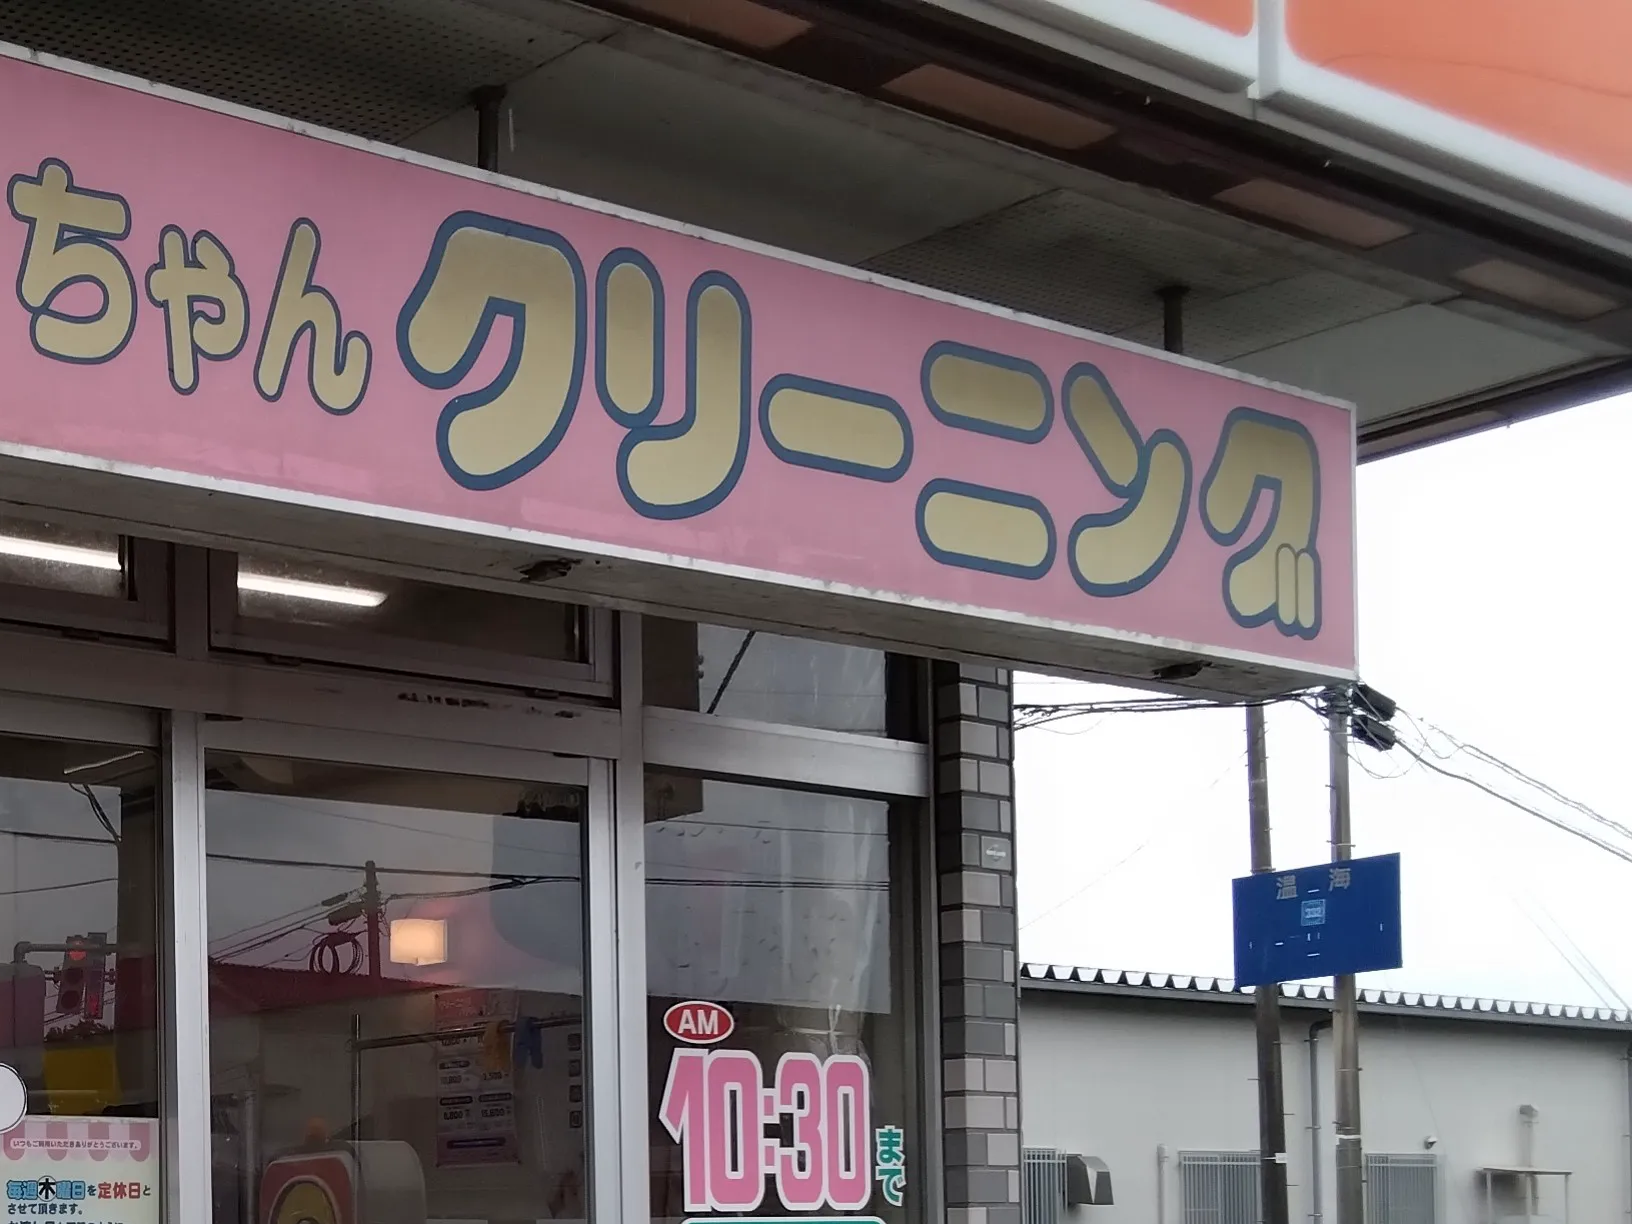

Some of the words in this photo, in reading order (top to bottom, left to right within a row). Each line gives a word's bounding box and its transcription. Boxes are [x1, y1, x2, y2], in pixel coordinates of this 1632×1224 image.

[678, 1009, 719, 1035] AM
[658, 1047, 872, 1213] 10:30
[875, 1125, 907, 1207] まで
[7, 1203, 83, 1215] させて頂きます。
